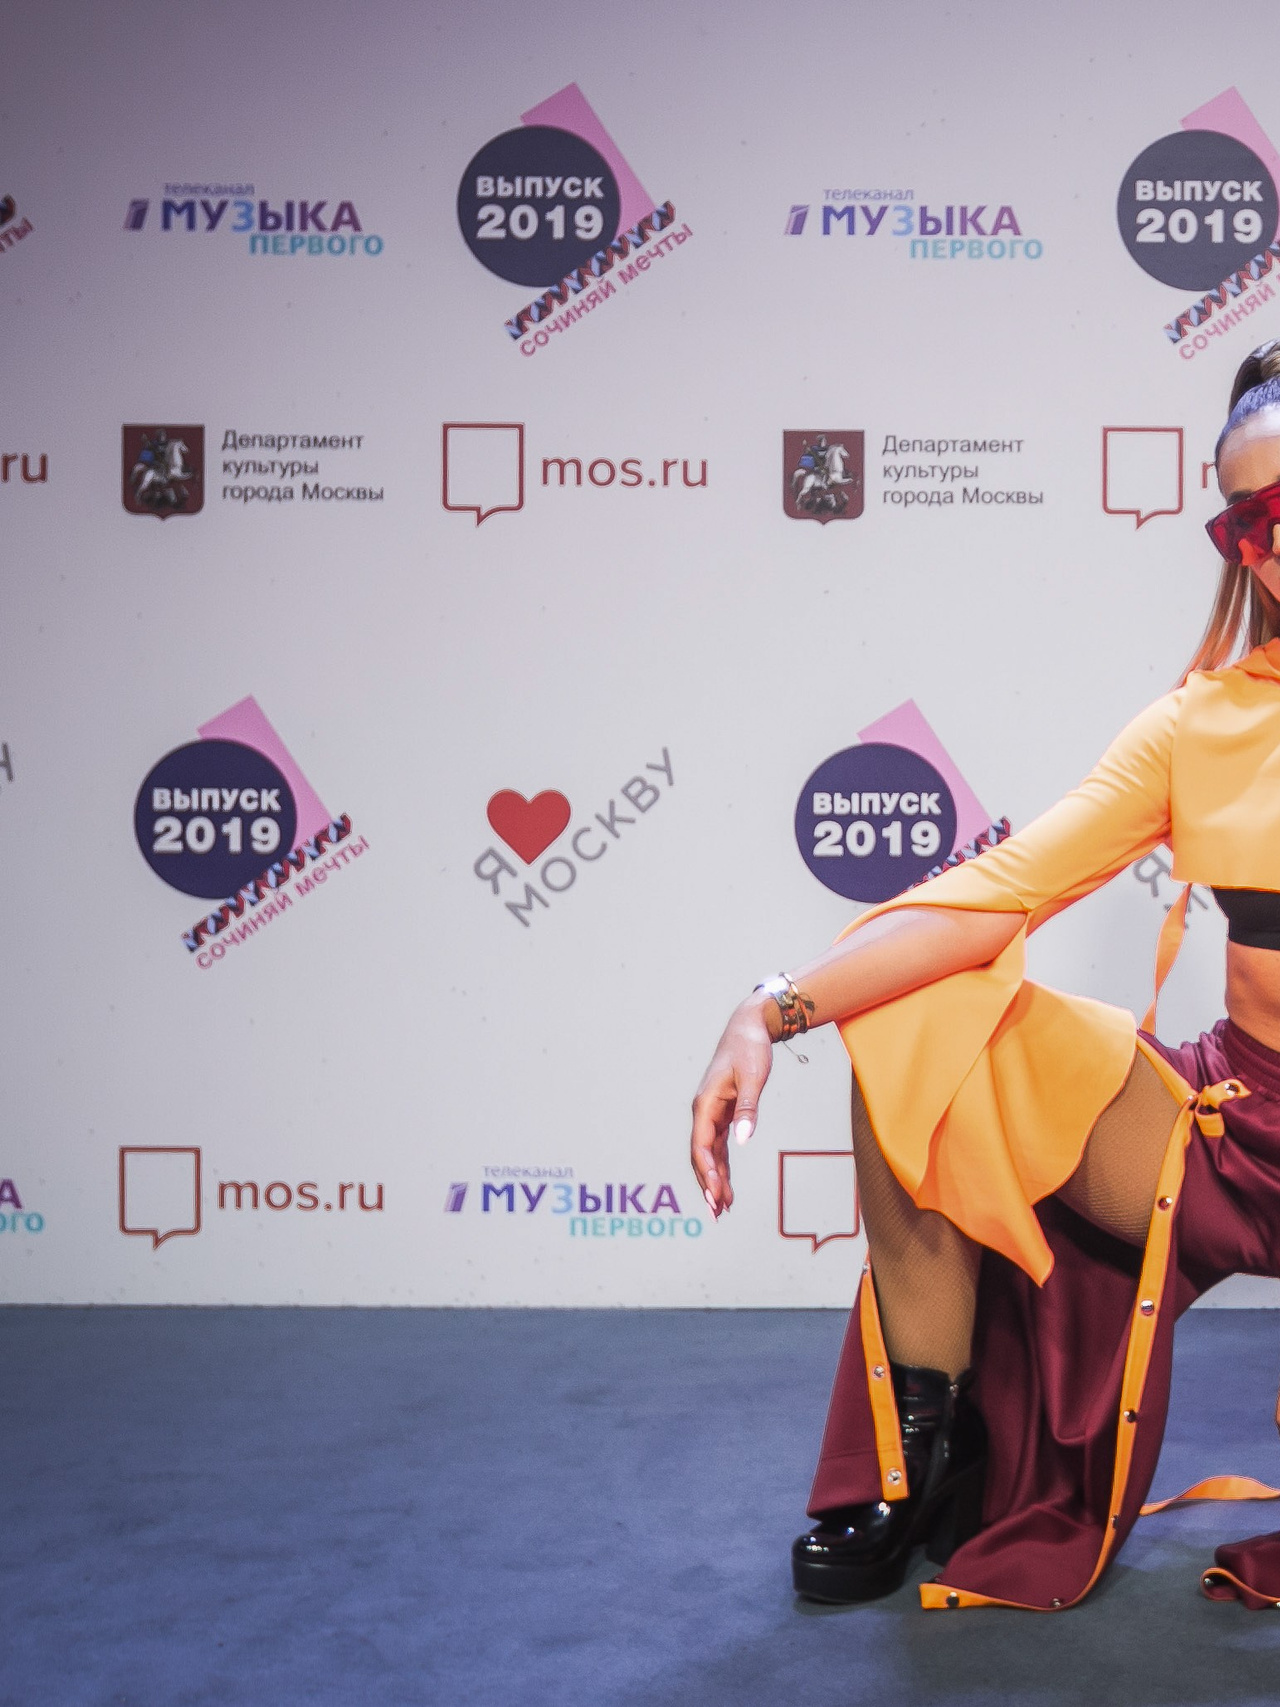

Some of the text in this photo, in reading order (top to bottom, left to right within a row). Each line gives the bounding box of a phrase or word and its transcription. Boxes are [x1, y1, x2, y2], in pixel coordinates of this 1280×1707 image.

[164, 183, 255, 196] телеканал
[477, 176, 604, 198] ВЫПУСК
[824, 189, 914, 201] телеканал
[1136, 180, 1263, 202] ВЫПУСК
[161, 199, 361, 231] МУЗЫКА
[477, 205, 603, 240] 2019
[822, 205, 1021, 236] МУЗЫКА
[1136, 208, 1262, 243] 2019
[249, 233, 383, 255] ПЕРВОГО
[910, 238, 1043, 259] ПЕРВОГО
[221, 430, 362, 451] Департамент
[882, 435, 1023, 456] Департамент
[222, 460, 318, 479] культуры
[542, 458, 707, 487] mos.ru
[883, 465, 978, 483] культуры
[222, 483, 383, 504] города Москвы
[883, 487, 1043, 508] города Москвы
[153, 788, 281, 812] ВЫПУСК
[813, 792, 941, 815] ВЫПУСК
[153, 817, 280, 853] 2019
[505, 748, 677, 927] МОСКВУ
[813, 821, 940, 856] 2019
[473, 848, 518, 895] Я
[484, 1166, 573, 1179] телеканал
[218, 1181, 383, 1211] mos.ru
[482, 1183, 680, 1213] МУЗЫКА
[570, 1215, 703, 1237] ПЕРВОГО
